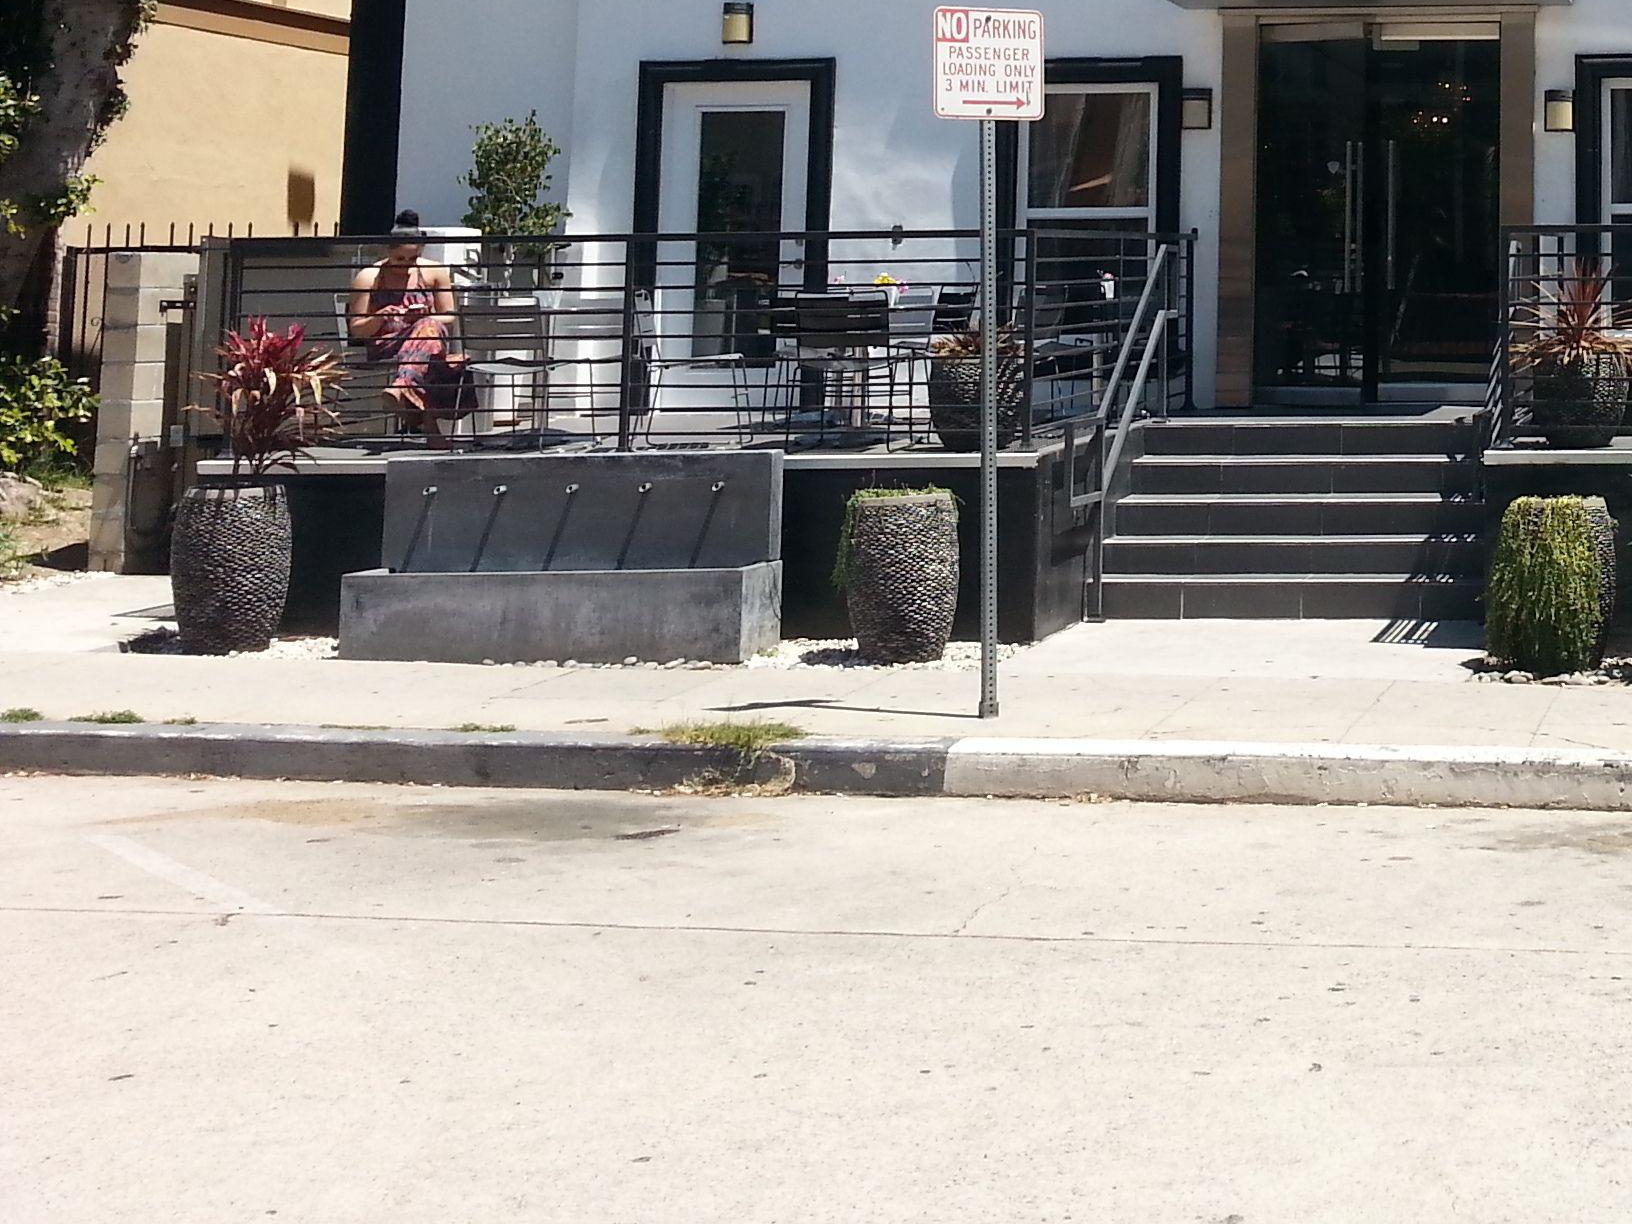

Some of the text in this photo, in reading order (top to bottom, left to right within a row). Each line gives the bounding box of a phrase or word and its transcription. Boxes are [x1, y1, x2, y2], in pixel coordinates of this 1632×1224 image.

[937, 11, 1037, 40] NO PARKING
[949, 45, 1030, 61] PASSENGER
[943, 62, 1036, 78] LOADING ONLY
[945, 78, 1034, 94] 3 MIN. LIMIT
